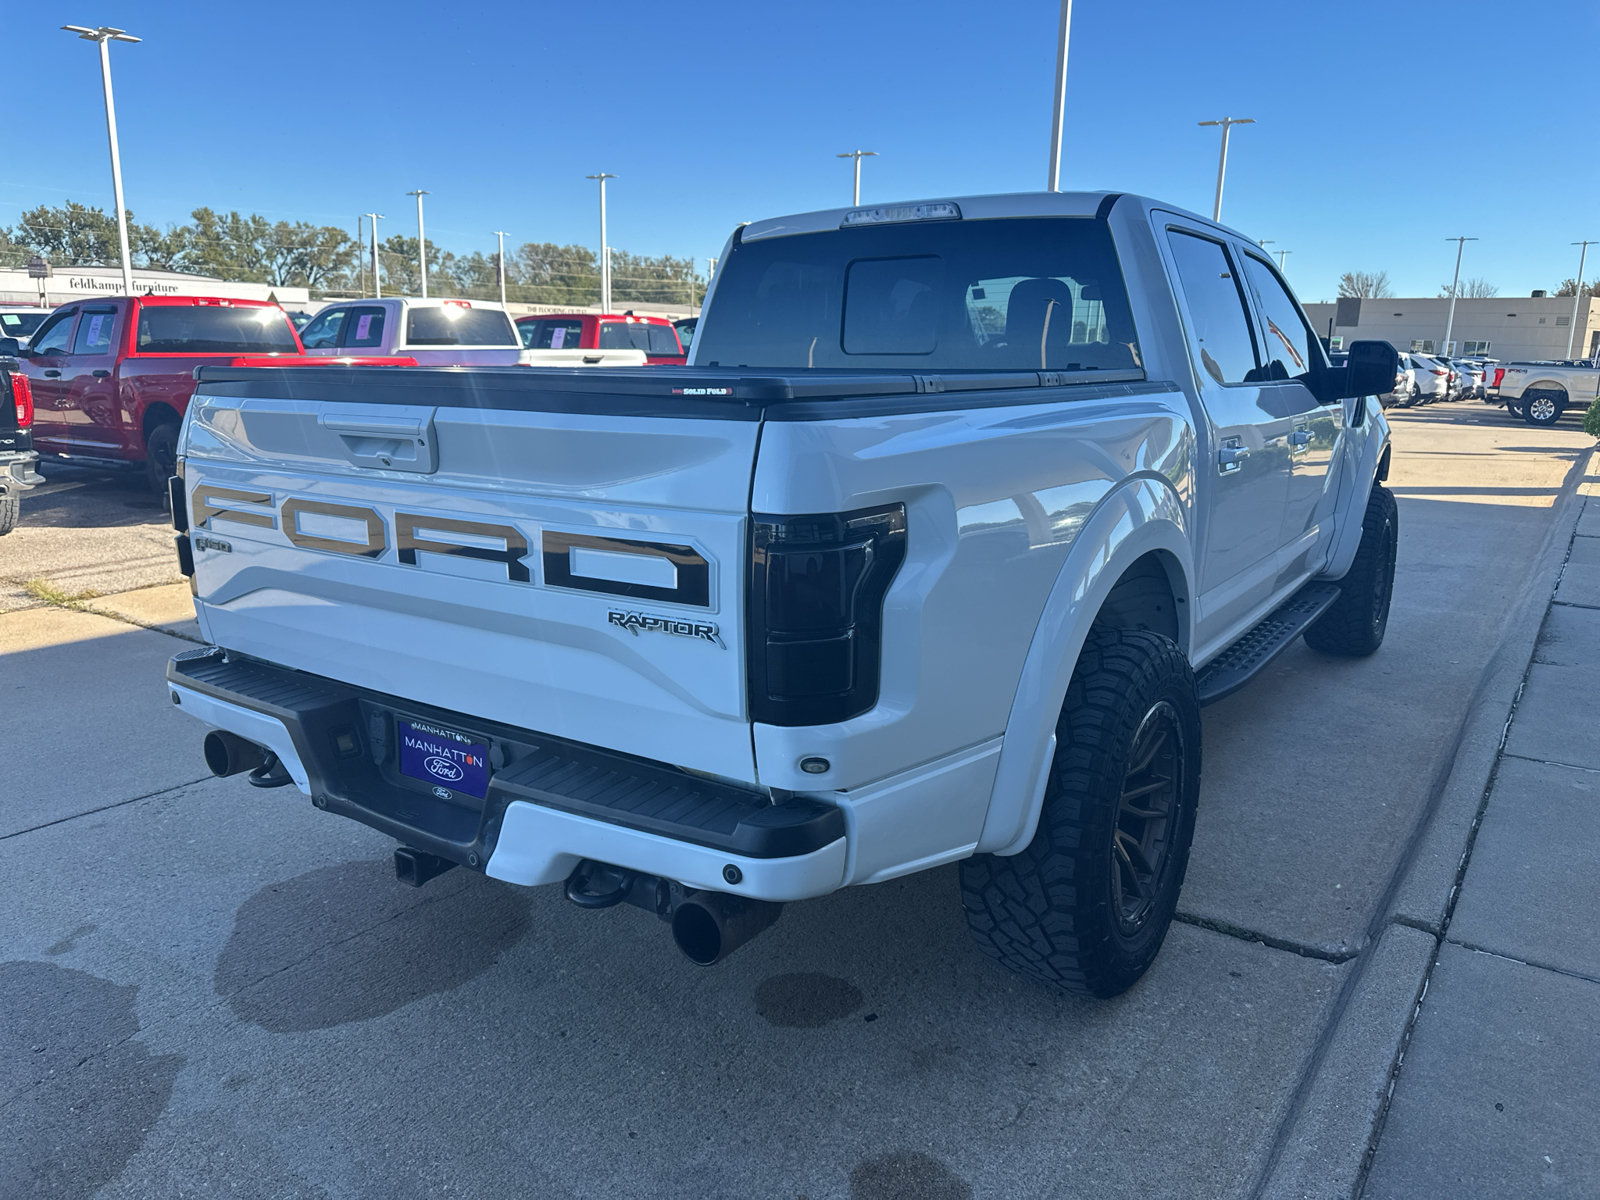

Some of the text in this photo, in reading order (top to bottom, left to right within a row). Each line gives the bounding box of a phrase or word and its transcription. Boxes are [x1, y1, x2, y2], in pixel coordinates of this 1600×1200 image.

[132, 281, 178, 292] furniture
[538, 306, 566, 314] FLOORING
[706, 387, 727, 395] FOLD
[193, 484, 711, 609] FORD
[608, 608, 726, 649] RAPTOR
[429, 758, 458, 778] Ford
[435, 787, 450, 798] Ford
